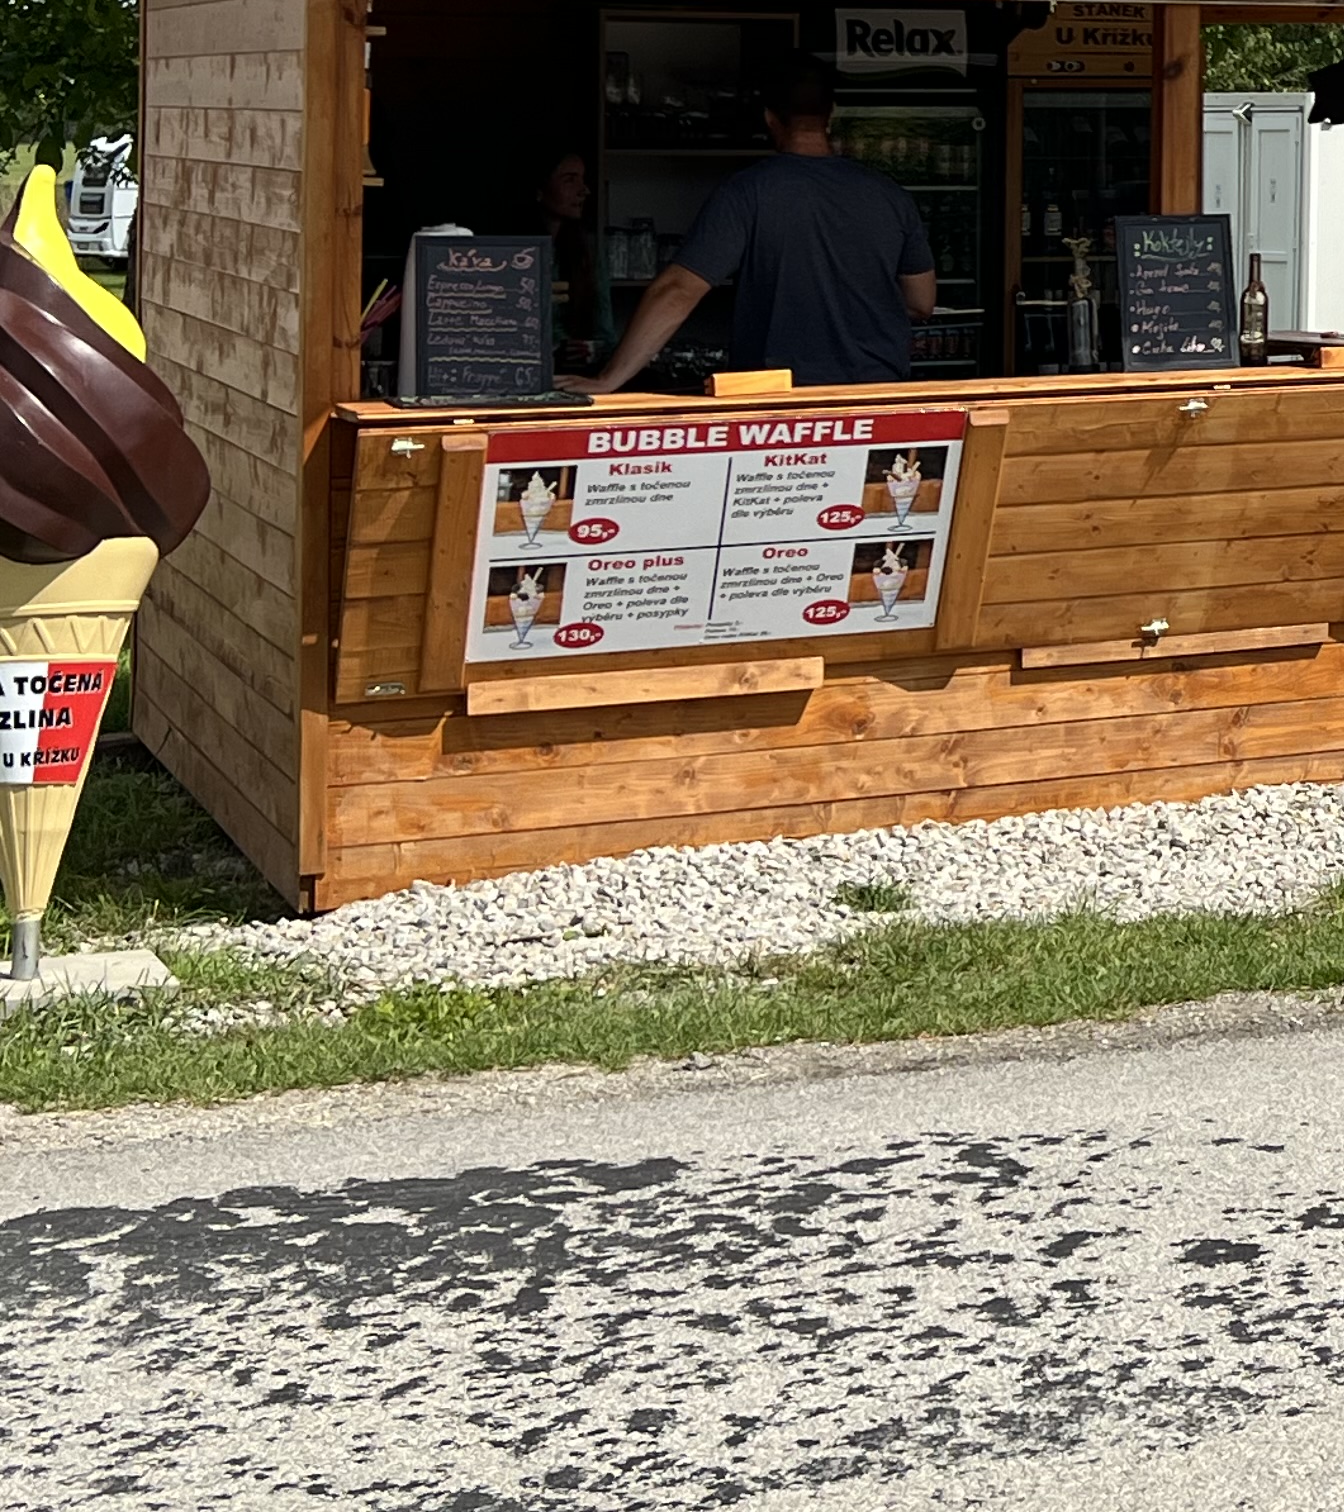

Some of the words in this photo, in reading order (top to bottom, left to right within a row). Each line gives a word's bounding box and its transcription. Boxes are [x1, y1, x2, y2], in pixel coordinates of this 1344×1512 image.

[845, 18, 957, 58] Relax
[1055, 27, 1074, 45] U
[588, 426, 729, 453] BUBBLE
[738, 419, 874, 446] WAFFLE
[764, 453, 828, 467] KitKat
[608, 461, 673, 476] Klasik
[736, 472, 774, 482] Waffle
[587, 483, 626, 494] Waffle
[584, 496, 647, 506] zmrzlinou
[733, 496, 770, 506] KitKat
[762, 548, 808, 559] Oreo
[588, 559, 636, 571] Oreo
[643, 556, 684, 570] plus
[723, 567, 759, 576] Waffle
[586, 577, 625, 586] Waffle
[816, 573, 844, 582] Oreo
[583, 601, 613, 610] Oreo
[13, 670, 103, 696] TOČENÁ
[3, 752, 14, 767] U
[20, 747, 80, 767] KŘÍŽKU
